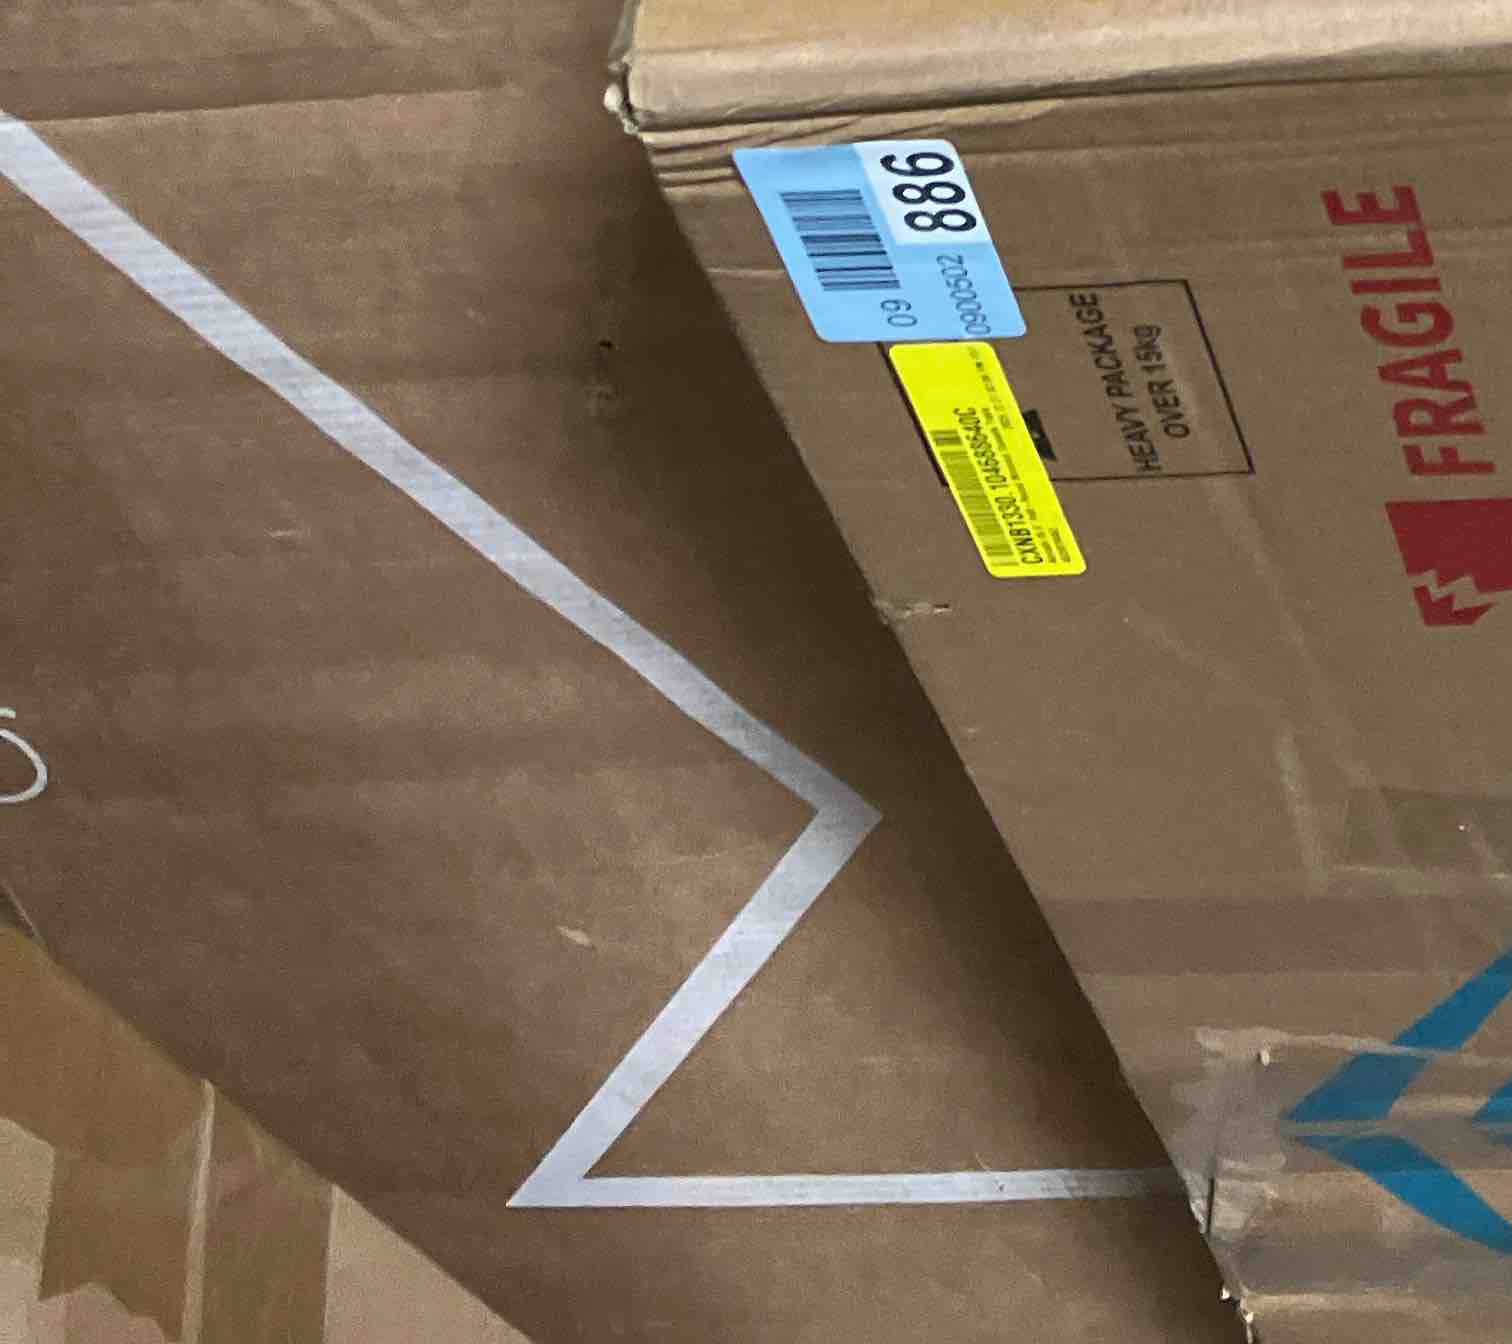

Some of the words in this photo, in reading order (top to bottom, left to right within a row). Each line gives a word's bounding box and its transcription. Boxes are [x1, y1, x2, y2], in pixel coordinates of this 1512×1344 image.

[879, 151, 977, 233] 886
[880, 298, 918, 328] 09
[936, 253, 992, 336] 0900502
[1320, 184, 1496, 478] FRAGILE
[1069, 292, 1135, 399] PACKAGE
[1133, 324, 1167, 374] 15kg
[1111, 402, 1164, 473] HEAVY
[1147, 378, 1190, 439] OVER
